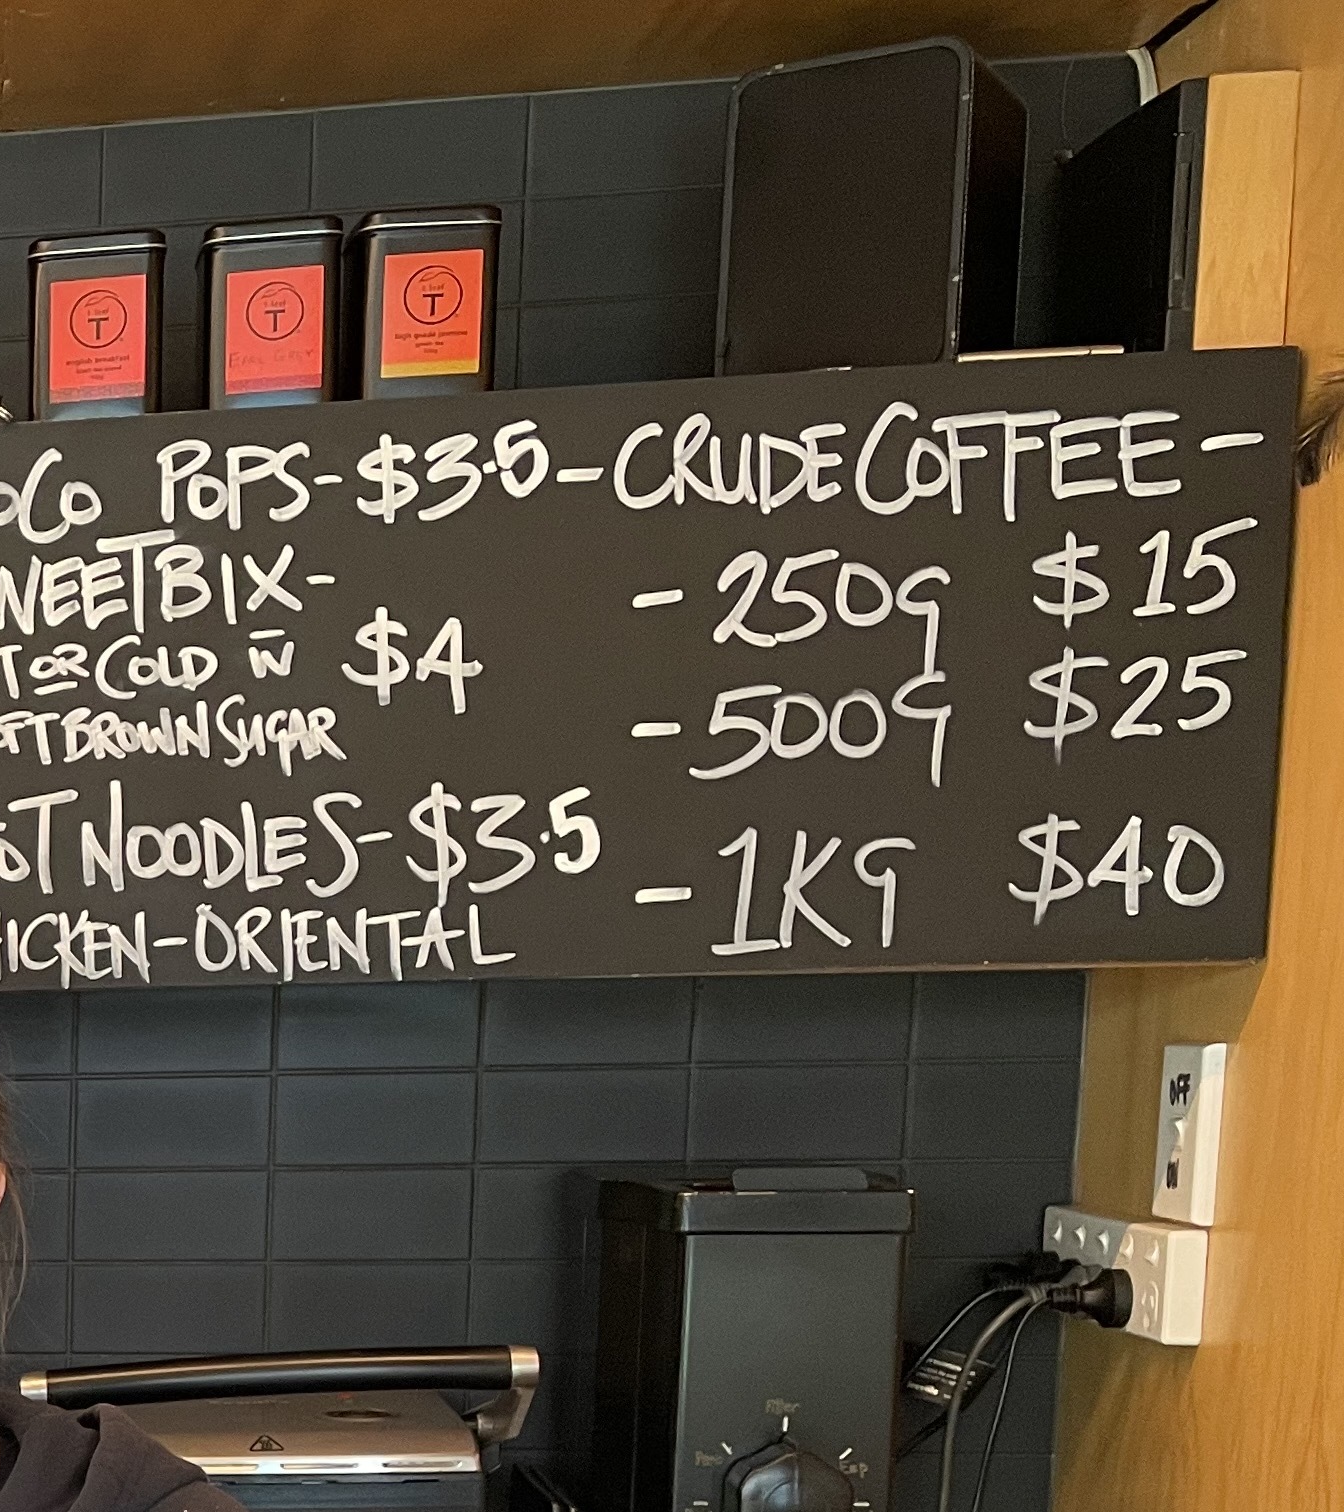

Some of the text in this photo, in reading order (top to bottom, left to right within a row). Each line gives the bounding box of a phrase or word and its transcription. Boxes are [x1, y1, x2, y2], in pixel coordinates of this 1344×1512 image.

[87, 316, 110, 340] T
[264, 309, 286, 333] T
[421, 292, 445, 317] T
[855, 401, 1183, 523] COFFEE
[94, 634, 218, 700] COLD
[340, 605, 484, 715] $4
[1022, 644, 1248, 767] $25
[61, 700, 211, 764] BROWN
[215, 694, 347, 778] SUGAR
[79, 778, 365, 899] NOODLES
[1007, 811, 1226, 928] $40
